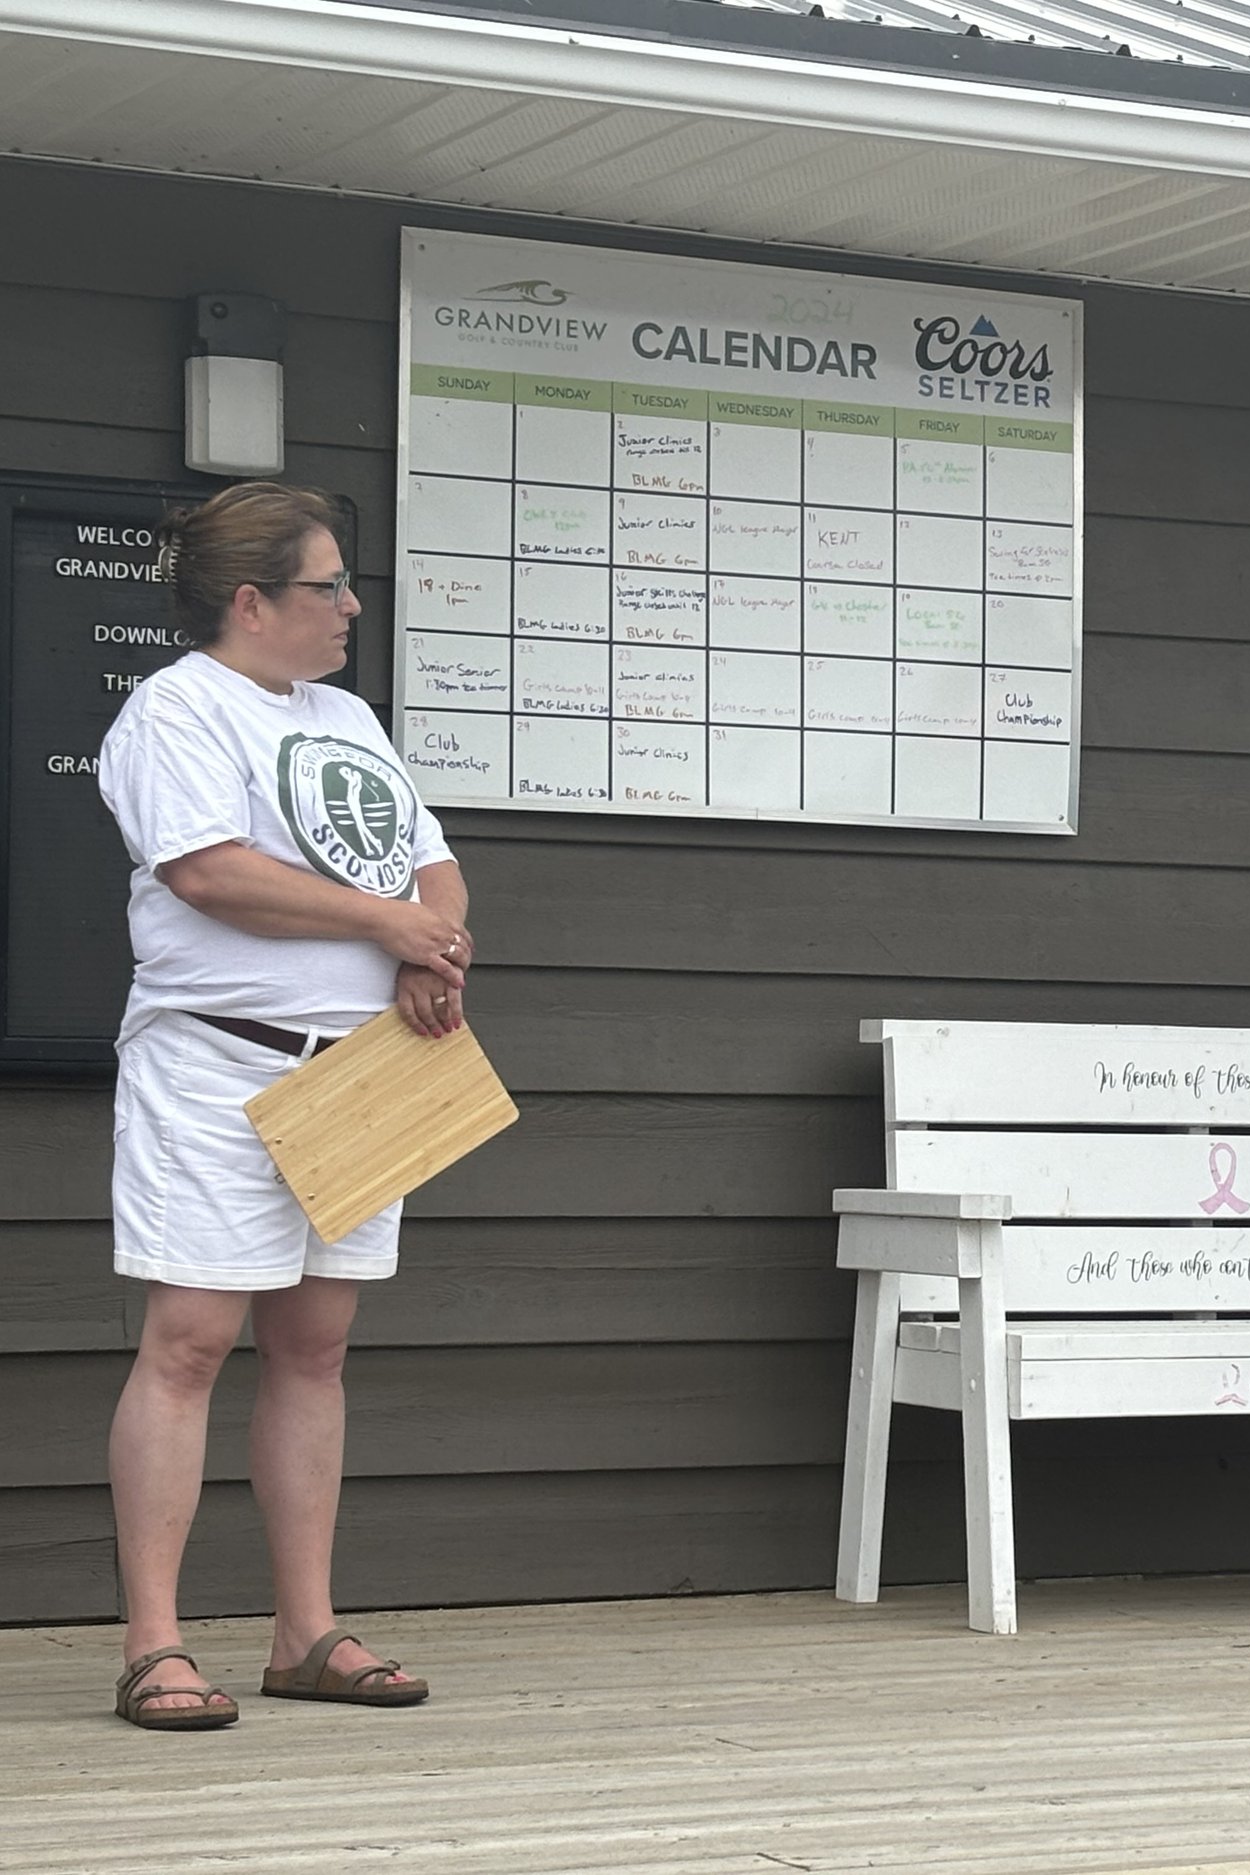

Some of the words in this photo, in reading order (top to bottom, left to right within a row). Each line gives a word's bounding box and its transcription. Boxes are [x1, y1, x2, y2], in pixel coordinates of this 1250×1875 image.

[767, 293, 853, 325] 2024
[435, 307, 607, 341] GRANDVIEW
[458, 333, 486, 343] GOLF
[502, 338, 549, 349] COUNTRY
[554, 342, 578, 352] CLUB
[913, 315, 1054, 382] Coors
[632, 322, 877, 380] CALENDAR
[437, 376, 490, 392] SUNDAY
[918, 374, 1051, 408] SELTZER
[535, 385, 591, 401] MONDAY
[632, 393, 689, 410] TUESDAY
[717, 401, 795, 418] WEDNESDAY
[817, 410, 881, 427] THURSDAY
[919, 419, 960, 434] FRIDAY
[618, 434, 655, 447] Junior
[998, 427, 1057, 442] SATURDAY
[807, 437, 814, 449] 4
[618, 517, 653, 530] Junior
[808, 512, 816, 523] 11
[77, 525, 152, 547] WELCO
[818, 530, 861, 548] KENT
[56, 558, 164, 583] GRANDVIE
[412, 560, 424, 571] 14
[519, 566, 532, 577] 15
[418, 577, 434, 594] 18
[990, 600, 1004, 608] 20
[95, 624, 190, 647] DOWNLO
[411, 637, 424, 648] 21
[617, 649, 632, 662] 23
[713, 656, 727, 666] 24
[416, 655, 455, 674] Junior
[807, 660, 825, 671] 25
[990, 673, 1006, 683] 27
[1005, 693, 1034, 708] Club
[410, 716, 428, 728] 28
[516, 721, 531, 731] 29
[996, 708, 1063, 728] Championship
[617, 727, 630, 738] 30
[713, 729, 727, 741] 31
[424, 733, 460, 751] Club
[48, 755, 100, 775] GRAN
[1094, 1061, 1116, 1093] In
[1122, 1062, 1178, 1092] honour
[1184, 1065, 1206, 1099] of
[1067, 1251, 1119, 1284] And
[1126, 1251, 1173, 1283] those
[1180, 1250, 1212, 1281] who
